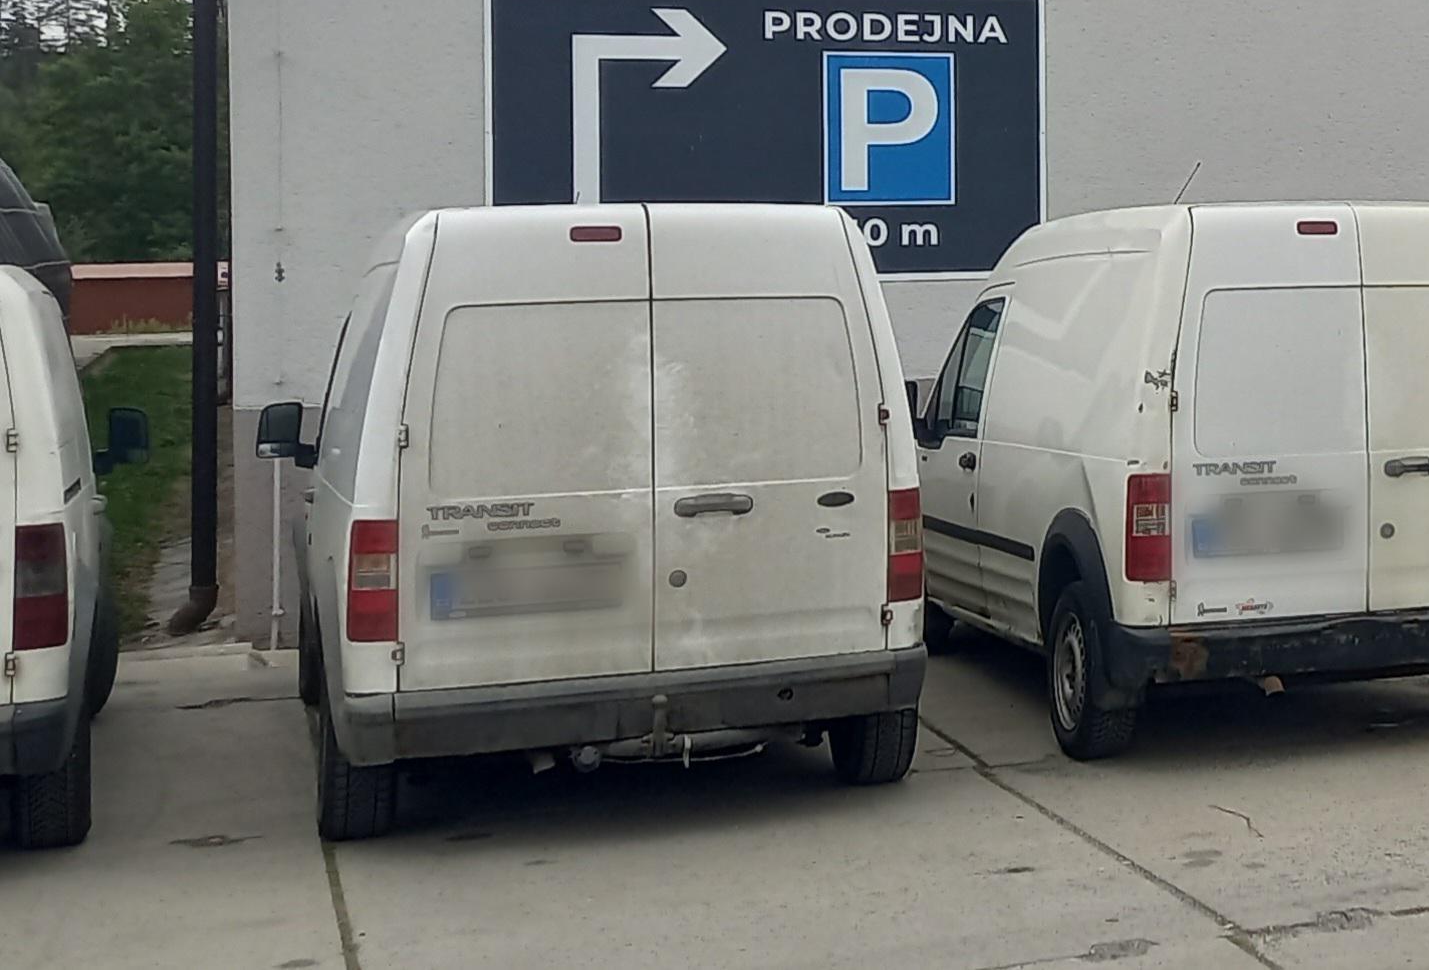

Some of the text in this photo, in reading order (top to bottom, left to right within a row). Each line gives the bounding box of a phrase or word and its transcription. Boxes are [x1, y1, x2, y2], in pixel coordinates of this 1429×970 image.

[764, 10, 1008, 44] PRODEJNA
[841, 68, 938, 191] P
[853, 217, 940, 247] 0 m
[1192, 460, 1277, 476] TRANSIT
[426, 502, 535, 520] TRANSIT
